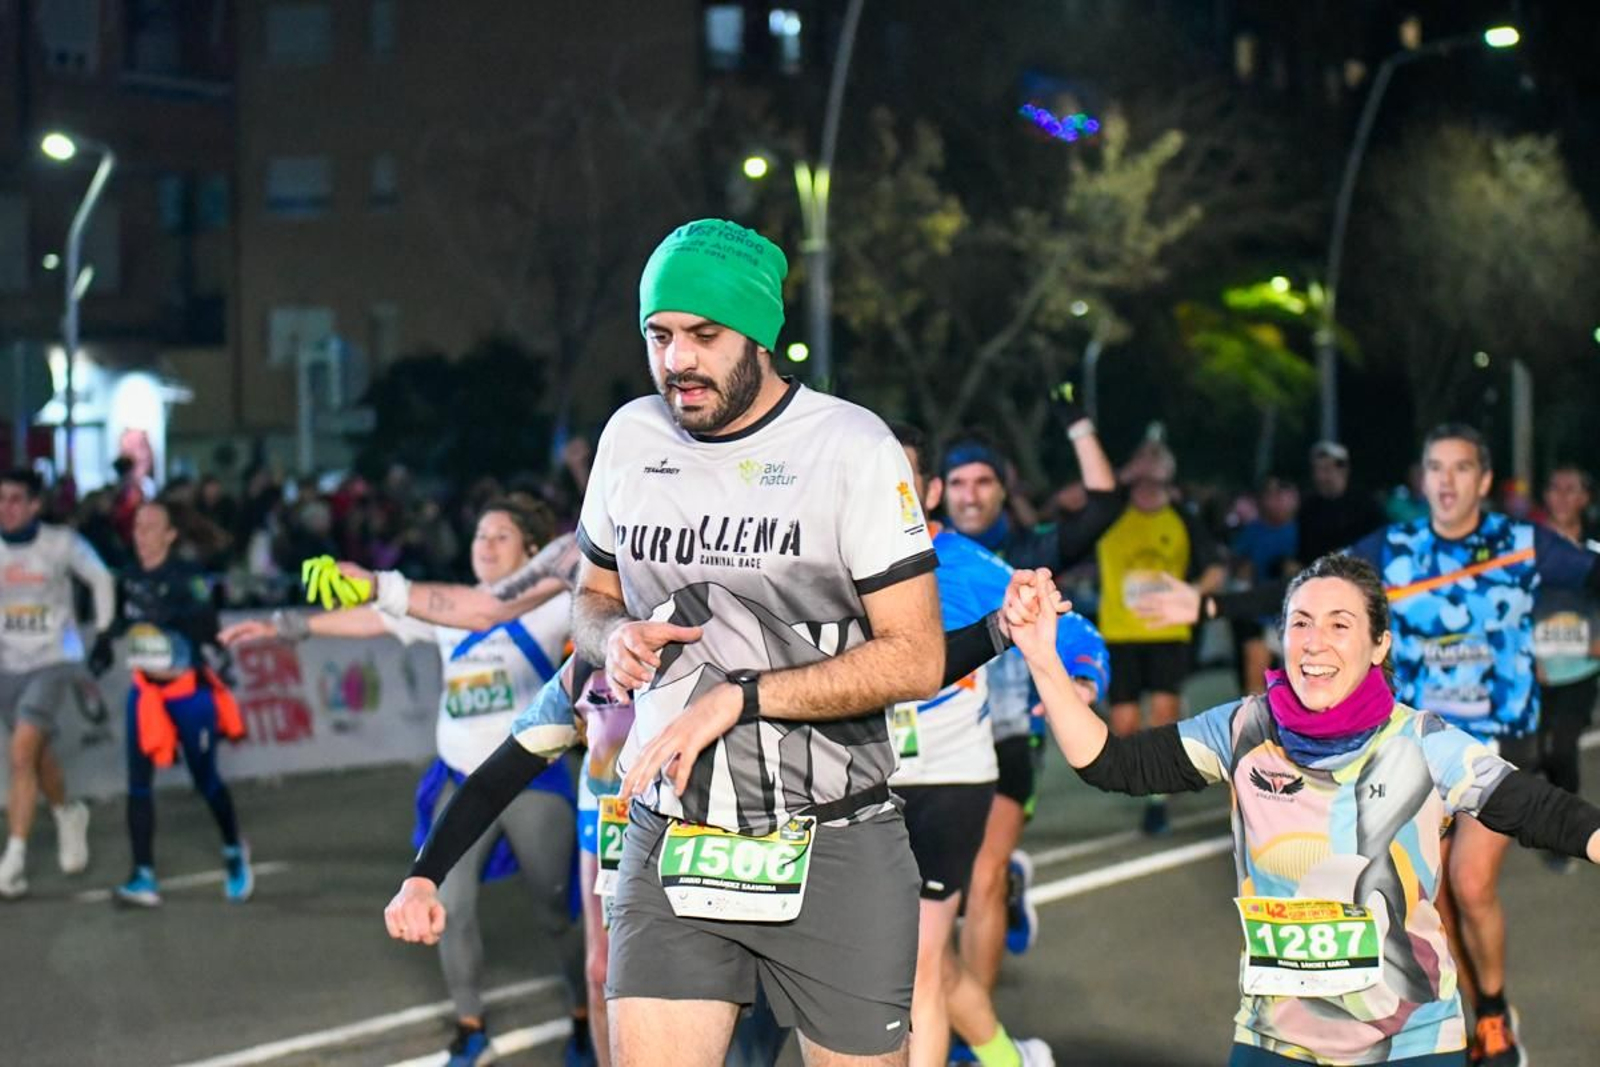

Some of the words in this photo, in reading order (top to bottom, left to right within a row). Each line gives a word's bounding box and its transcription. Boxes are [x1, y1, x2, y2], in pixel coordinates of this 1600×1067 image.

[764, 460, 786, 474] avi
[759, 474, 798, 486] natur
[699, 554, 734, 568] CARNIVAL
[738, 556, 762, 570] RACE
[673, 835, 797, 883] 1506
[1265, 902, 1288, 919] 42
[1256, 921, 1366, 960] 1287
